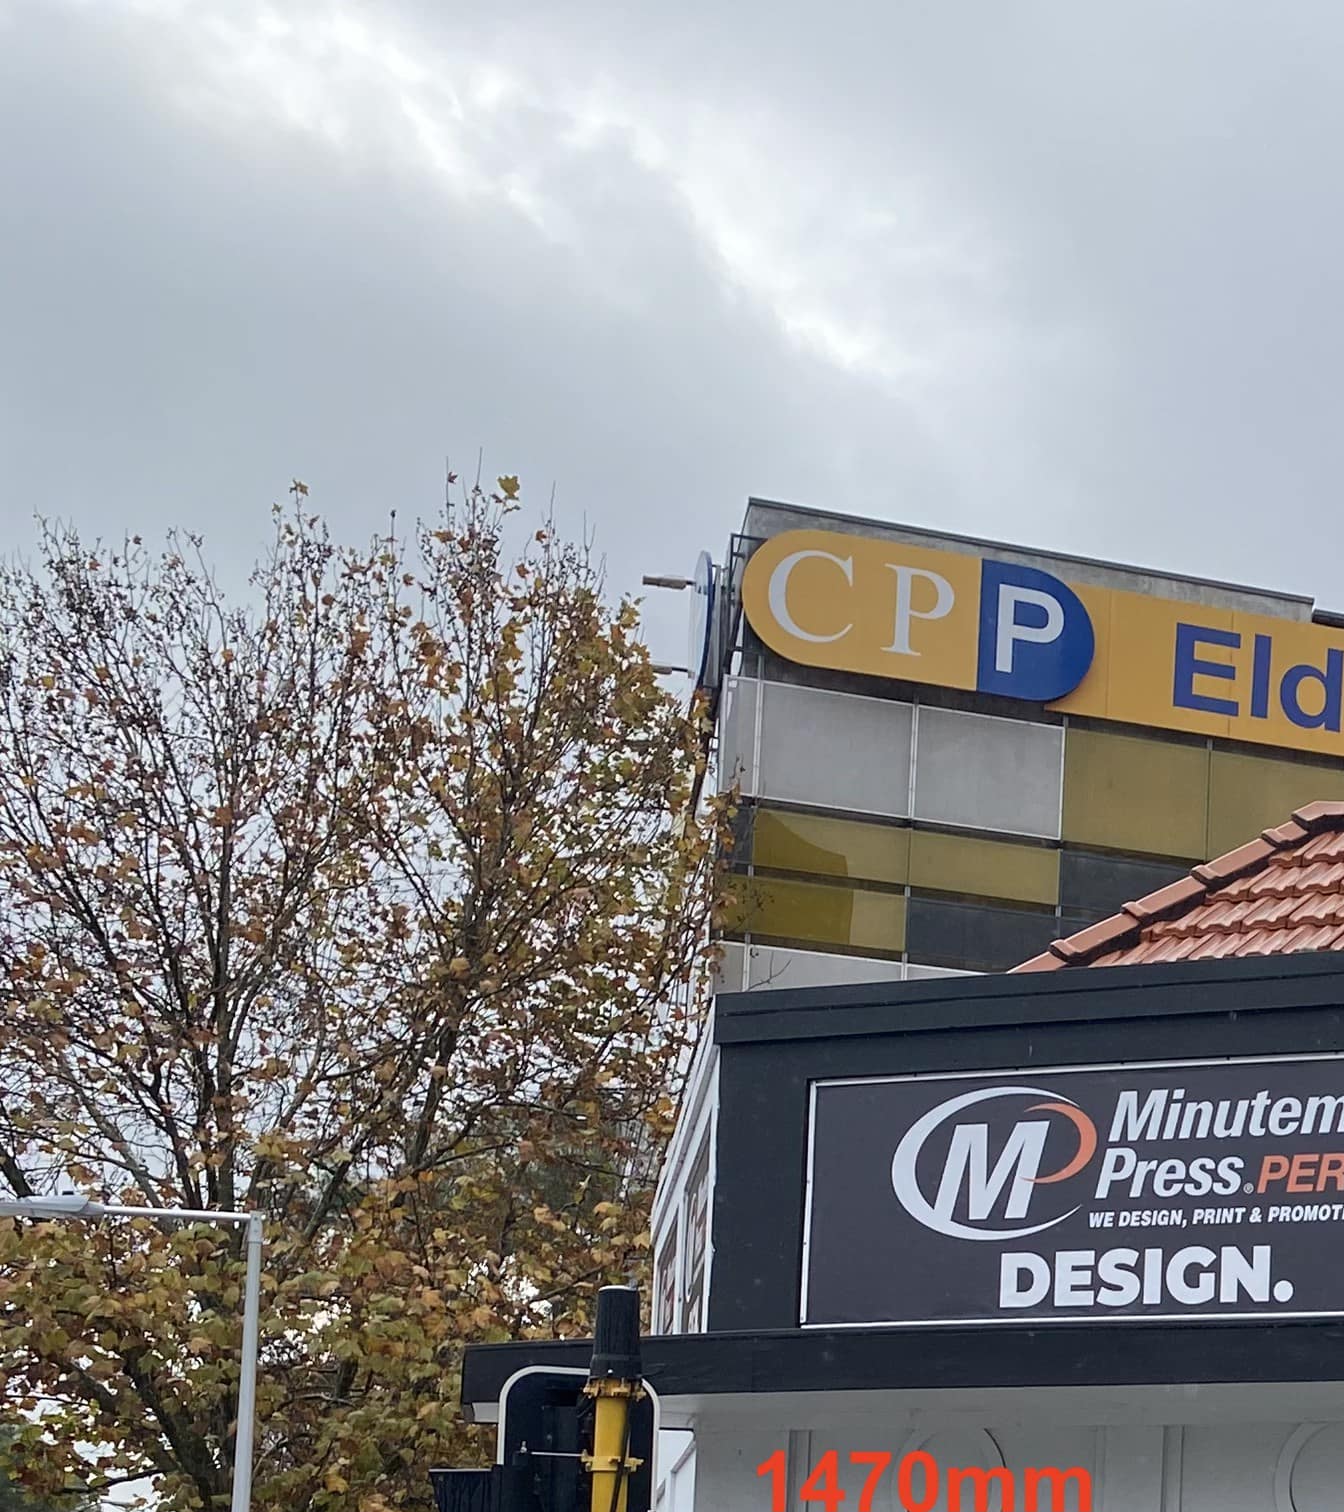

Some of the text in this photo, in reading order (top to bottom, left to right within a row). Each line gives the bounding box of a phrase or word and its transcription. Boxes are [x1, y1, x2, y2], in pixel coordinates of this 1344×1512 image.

[1088, 1211, 1115, 1229] WE
[1117, 1208, 1189, 1229] DESIGN,
[1192, 1206, 1247, 1226] PRINT
[1249, 1206, 1262, 1223] &
[999, 1245, 1295, 1309] DESIGN.
